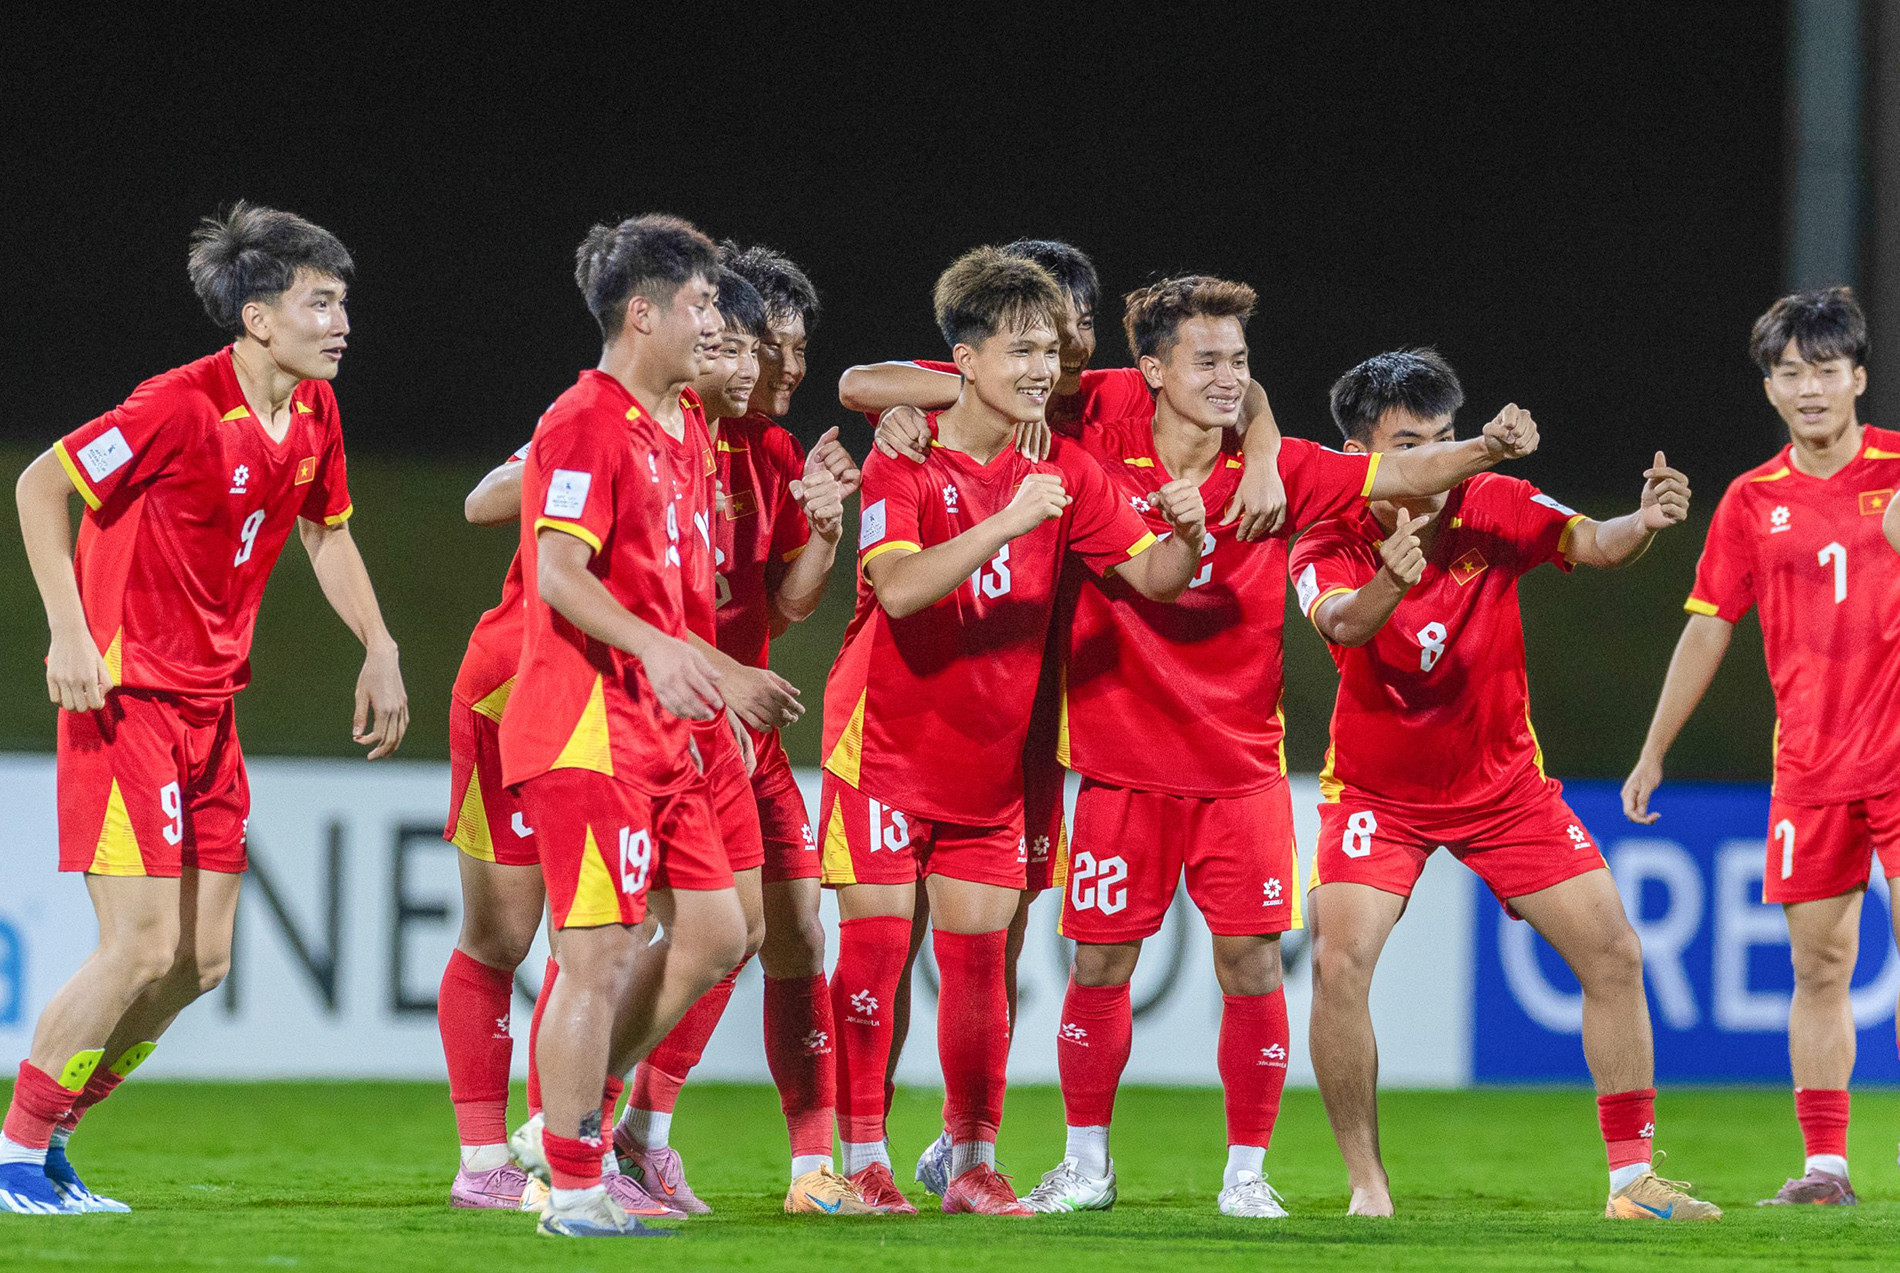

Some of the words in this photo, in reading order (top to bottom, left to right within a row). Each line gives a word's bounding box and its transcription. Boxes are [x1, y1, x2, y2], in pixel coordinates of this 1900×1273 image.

[234, 509, 265, 567] 9
[1417, 621, 1448, 672] 8
[160, 781, 183, 846] 9
[869, 797, 910, 853] 13
[1342, 810, 1378, 859] 8
[619, 825, 652, 895] 19
[1071, 850, 1128, 916] 22
